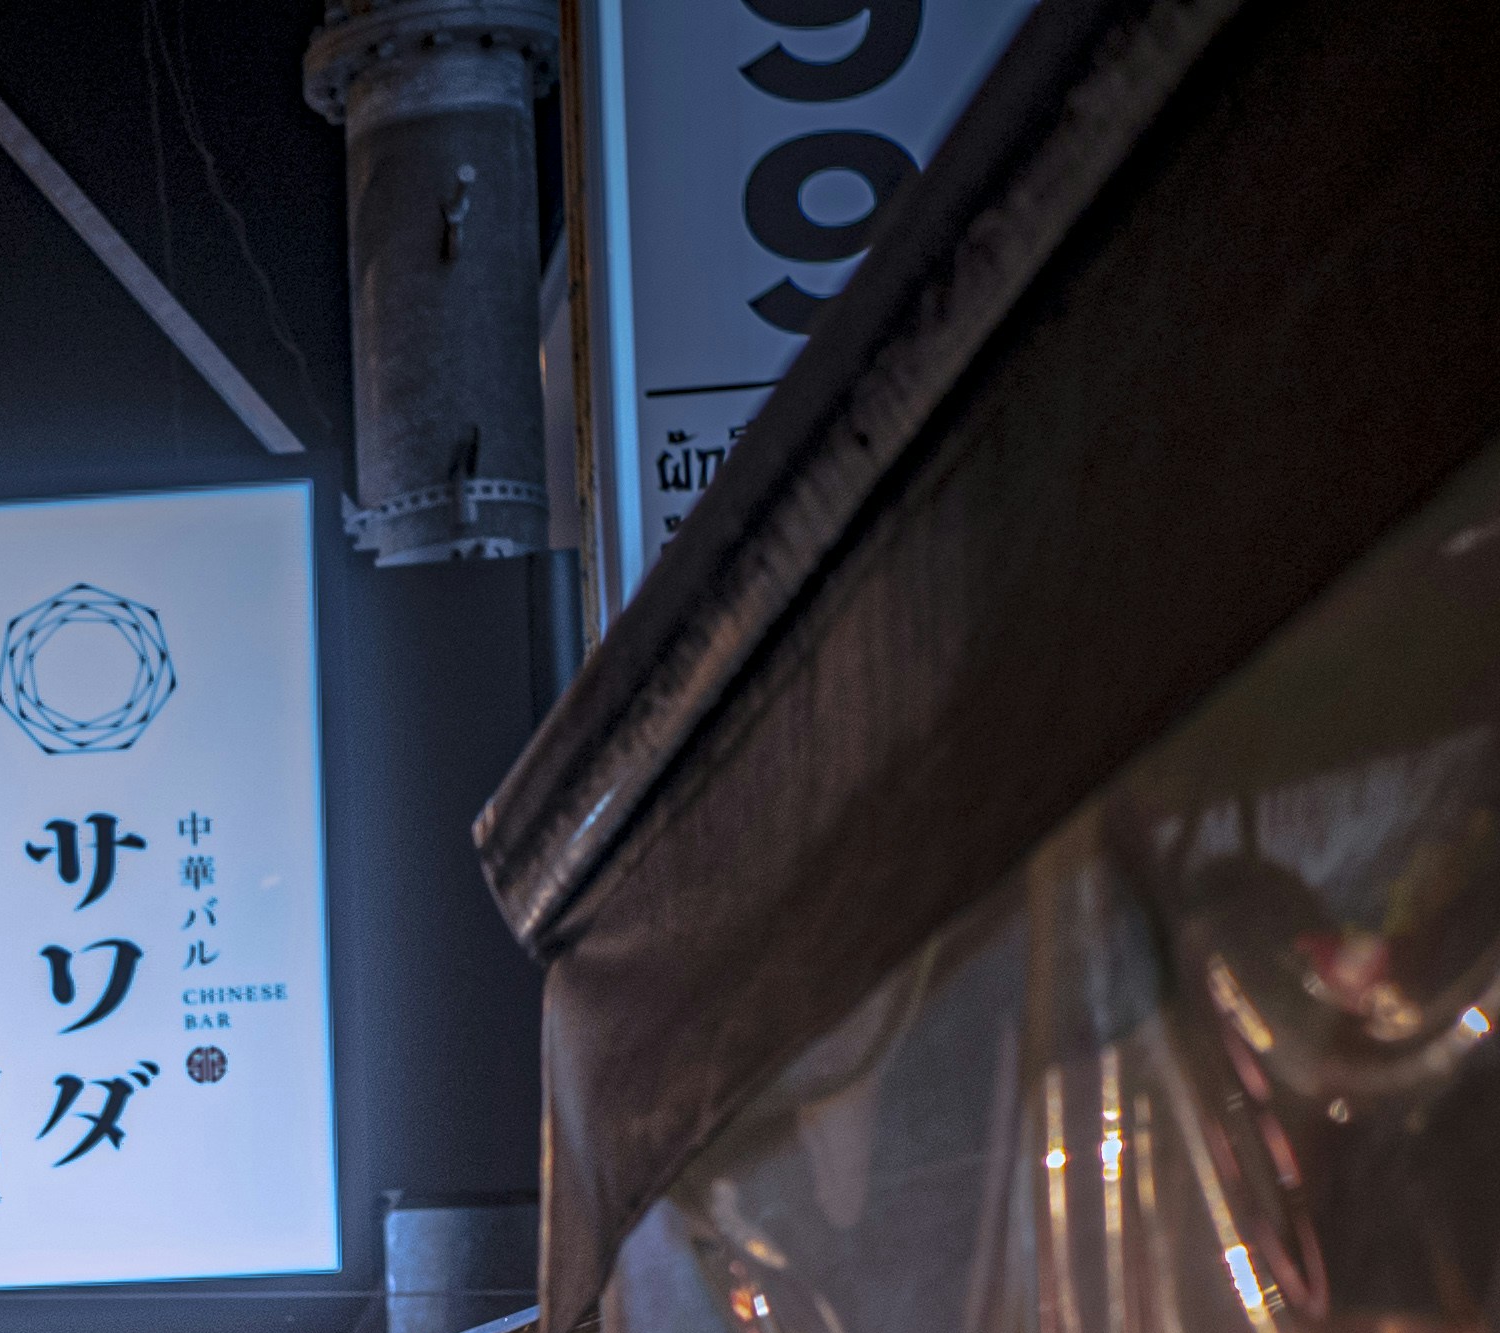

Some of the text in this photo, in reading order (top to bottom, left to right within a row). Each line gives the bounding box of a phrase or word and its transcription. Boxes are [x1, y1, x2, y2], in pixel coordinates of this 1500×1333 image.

[177, 811, 220, 970] 中華バル
[24, 812, 161, 1169] サワダ
[181, 983, 289, 1006] CHINESE
[183, 1012, 231, 1031] BAR
